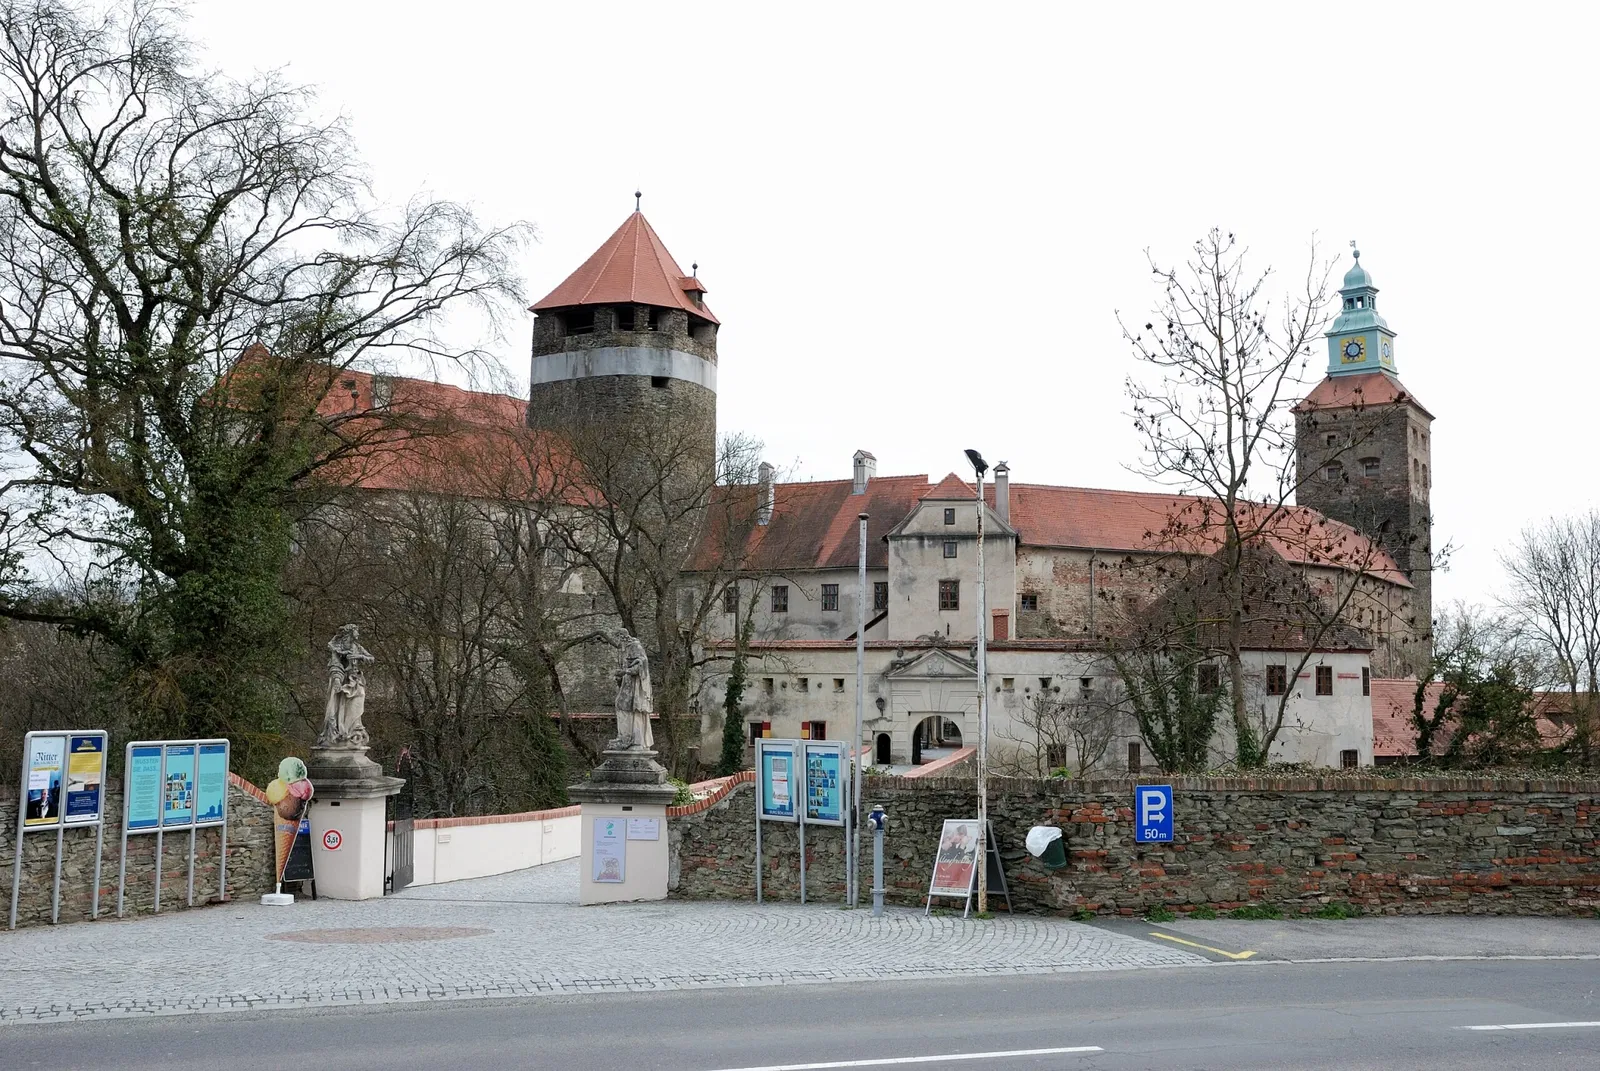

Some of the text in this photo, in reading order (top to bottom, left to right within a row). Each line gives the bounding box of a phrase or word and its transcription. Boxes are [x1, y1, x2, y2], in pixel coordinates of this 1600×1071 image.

[36, 752, 58, 761] Ritter
[1142, 791, 1166, 826] P
[1144, 828, 1158, 839] 50
